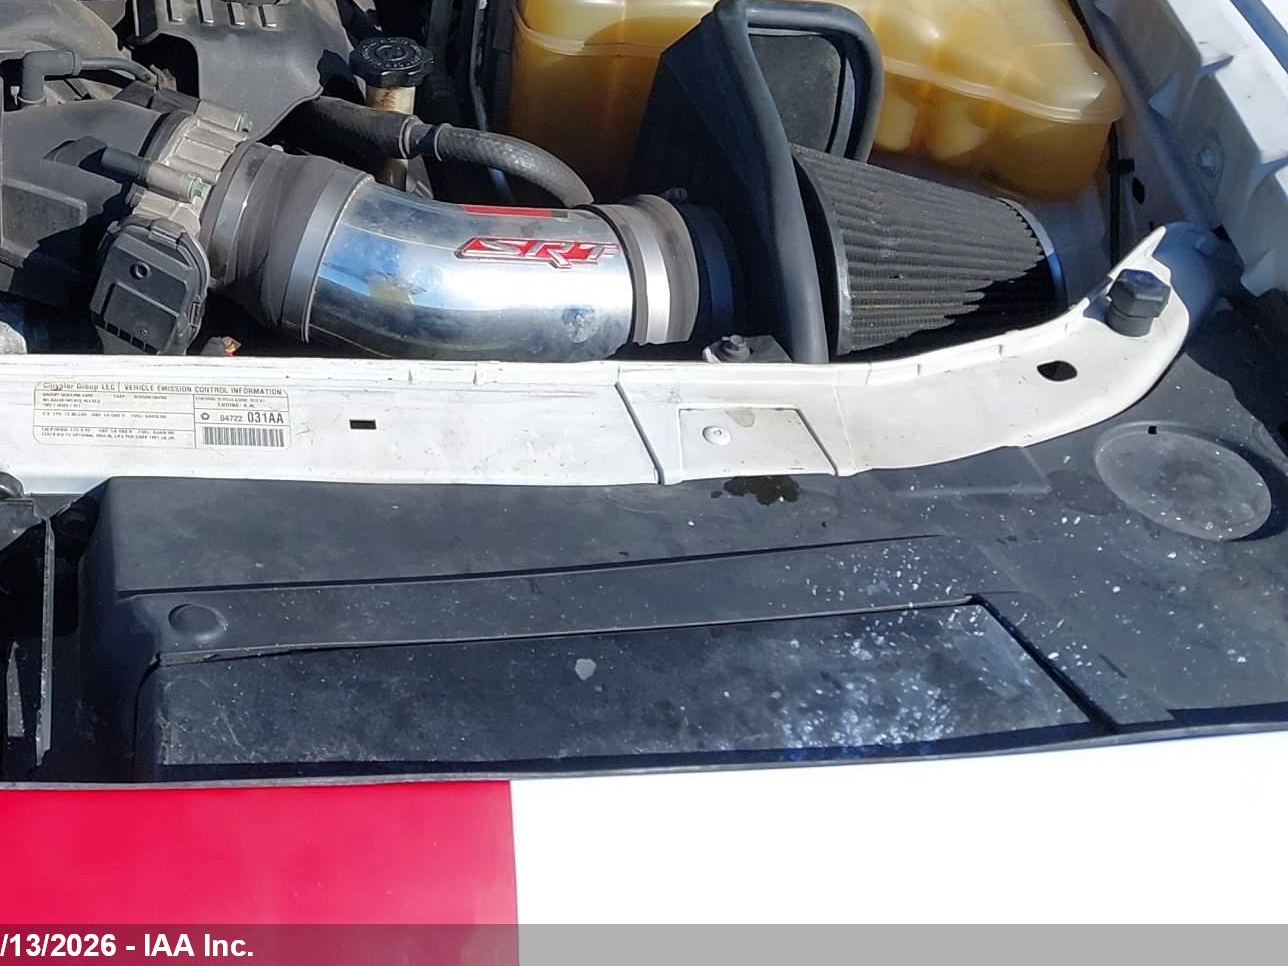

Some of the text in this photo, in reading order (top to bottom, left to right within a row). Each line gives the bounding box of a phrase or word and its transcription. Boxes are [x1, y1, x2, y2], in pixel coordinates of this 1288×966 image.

[461, 237, 620, 270] SRT
[76, 382, 100, 393] Group
[124, 384, 283, 396] VEHICLE EMISSION CONTROL INFORMATION
[219, 411, 285, 425] 04722 031AA
